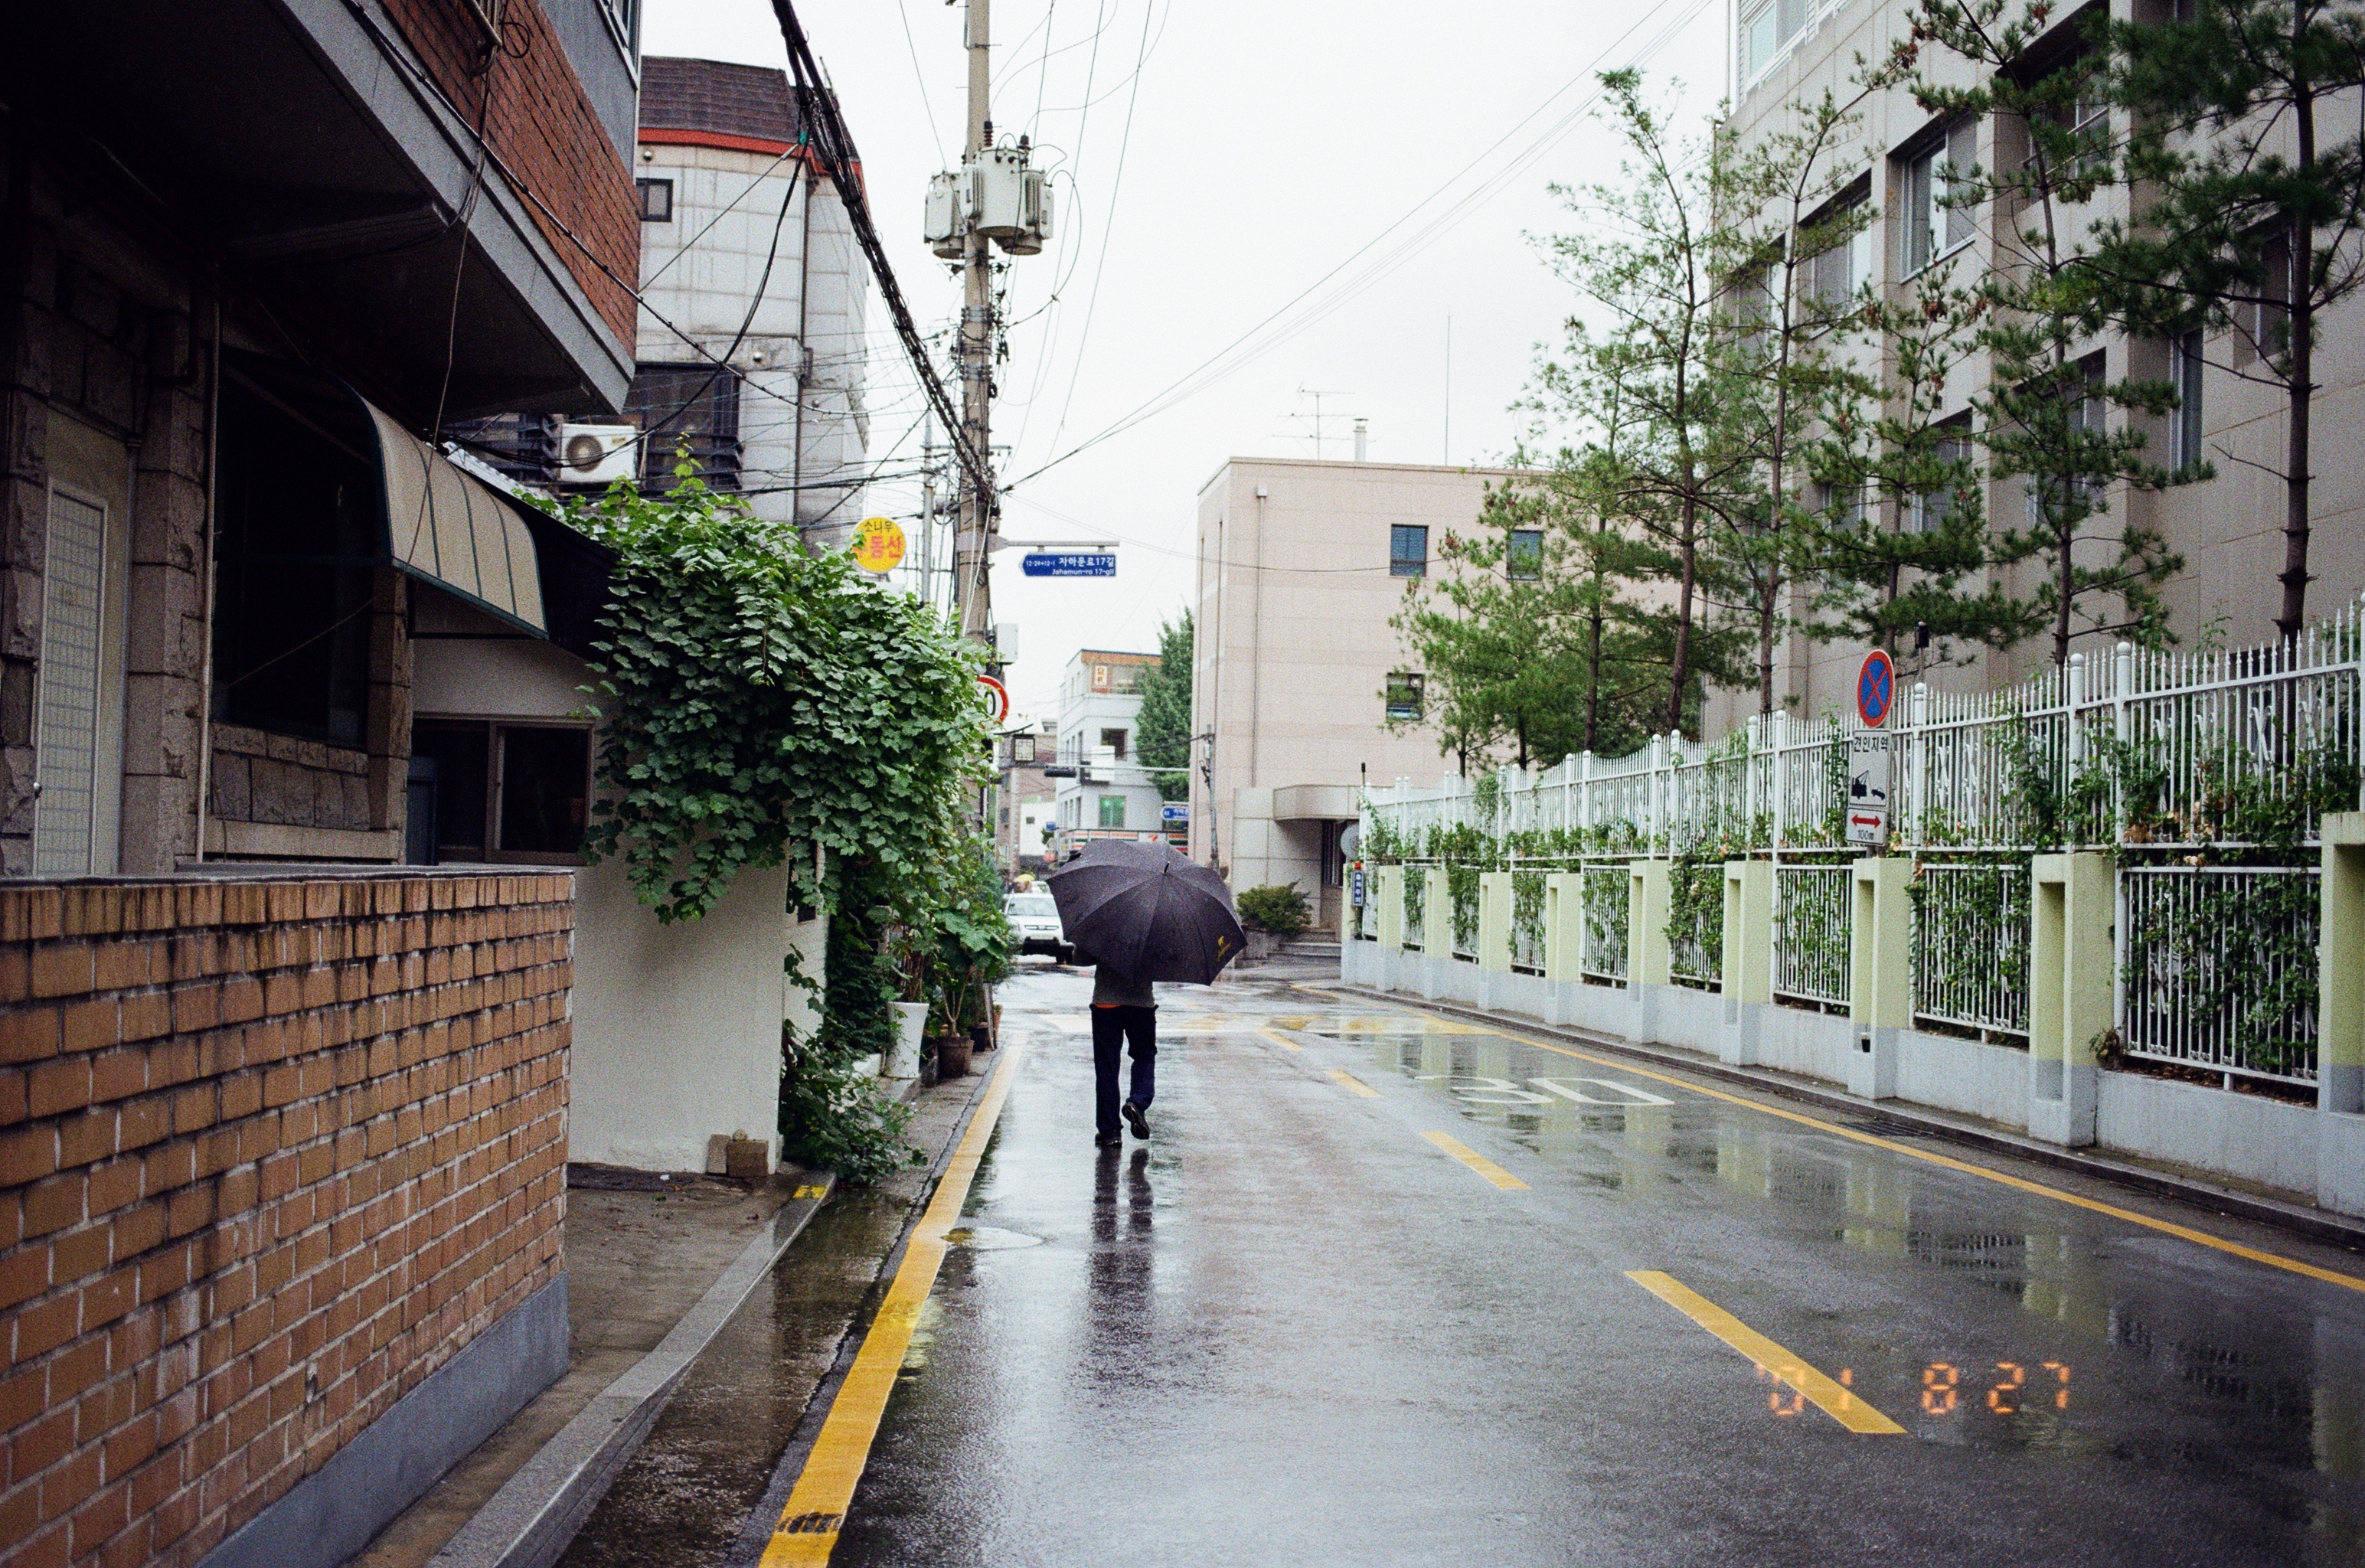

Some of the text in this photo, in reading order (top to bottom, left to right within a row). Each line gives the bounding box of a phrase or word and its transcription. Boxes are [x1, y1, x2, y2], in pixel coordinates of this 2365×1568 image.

[864, 521, 893, 533] 소나무
[1059, 557, 1114, 567] 자하문로17길
[1095, 568, 1114, 577] 17-gil
[1854, 737, 1889, 753] 견인지역
[1857, 830, 1874, 840] 100m
[1414, 1075, 1675, 1105] 30
